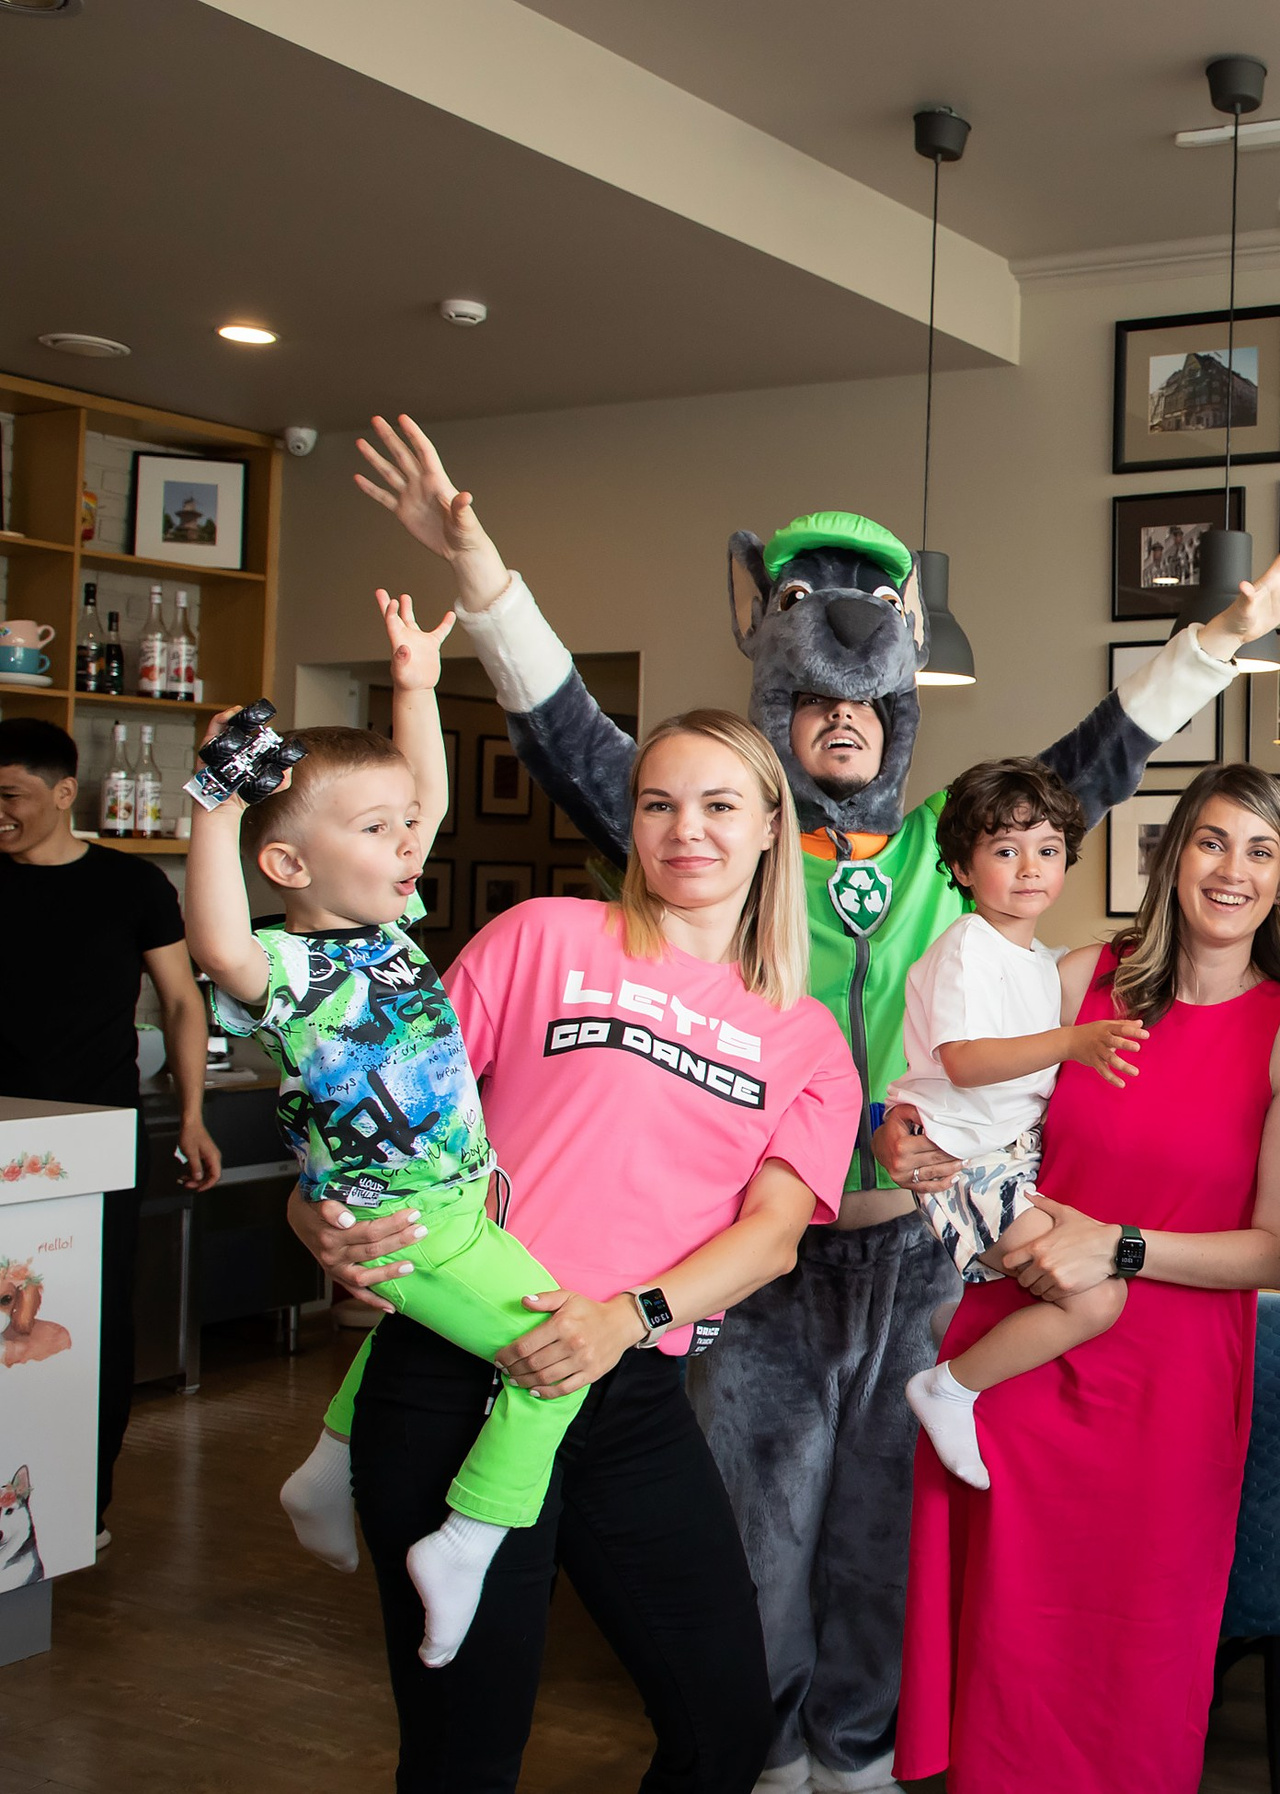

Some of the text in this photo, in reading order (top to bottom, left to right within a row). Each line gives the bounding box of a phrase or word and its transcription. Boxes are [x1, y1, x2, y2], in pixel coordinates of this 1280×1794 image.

[563, 970, 761, 1062] LET'S
[551, 1022, 761, 1105] GO DANCE
[37, 1235, 73, 1254] Hello!
